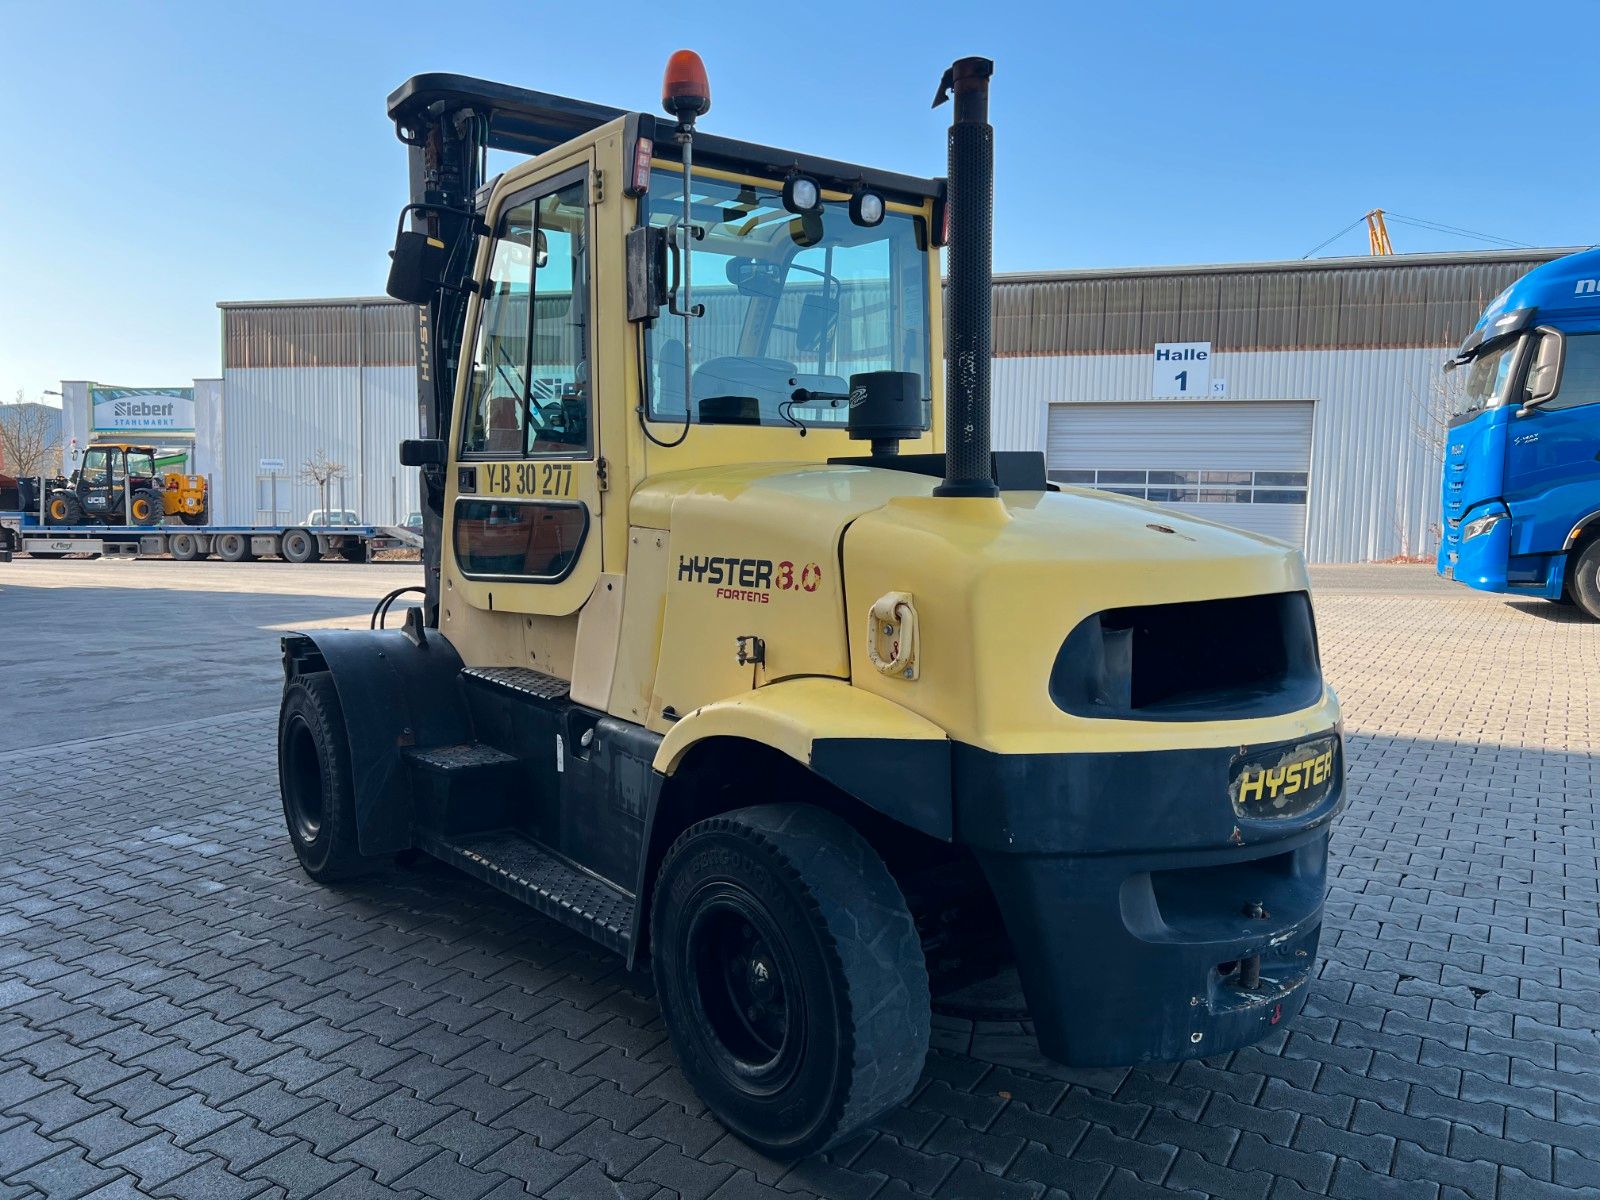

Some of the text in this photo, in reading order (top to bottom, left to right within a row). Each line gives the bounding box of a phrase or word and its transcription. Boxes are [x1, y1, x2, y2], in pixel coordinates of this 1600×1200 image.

[1156, 348, 1208, 361] Halle
[1174, 370, 1187, 391] 1
[114, 402, 173, 416] Siebert
[486, 463, 572, 496] Y-B 30 277
[87, 496, 106, 504] JCB
[678, 554, 773, 589] HYSTER
[716, 588, 770, 604] FORTENS
[1239, 749, 1333, 803] HYSTER
